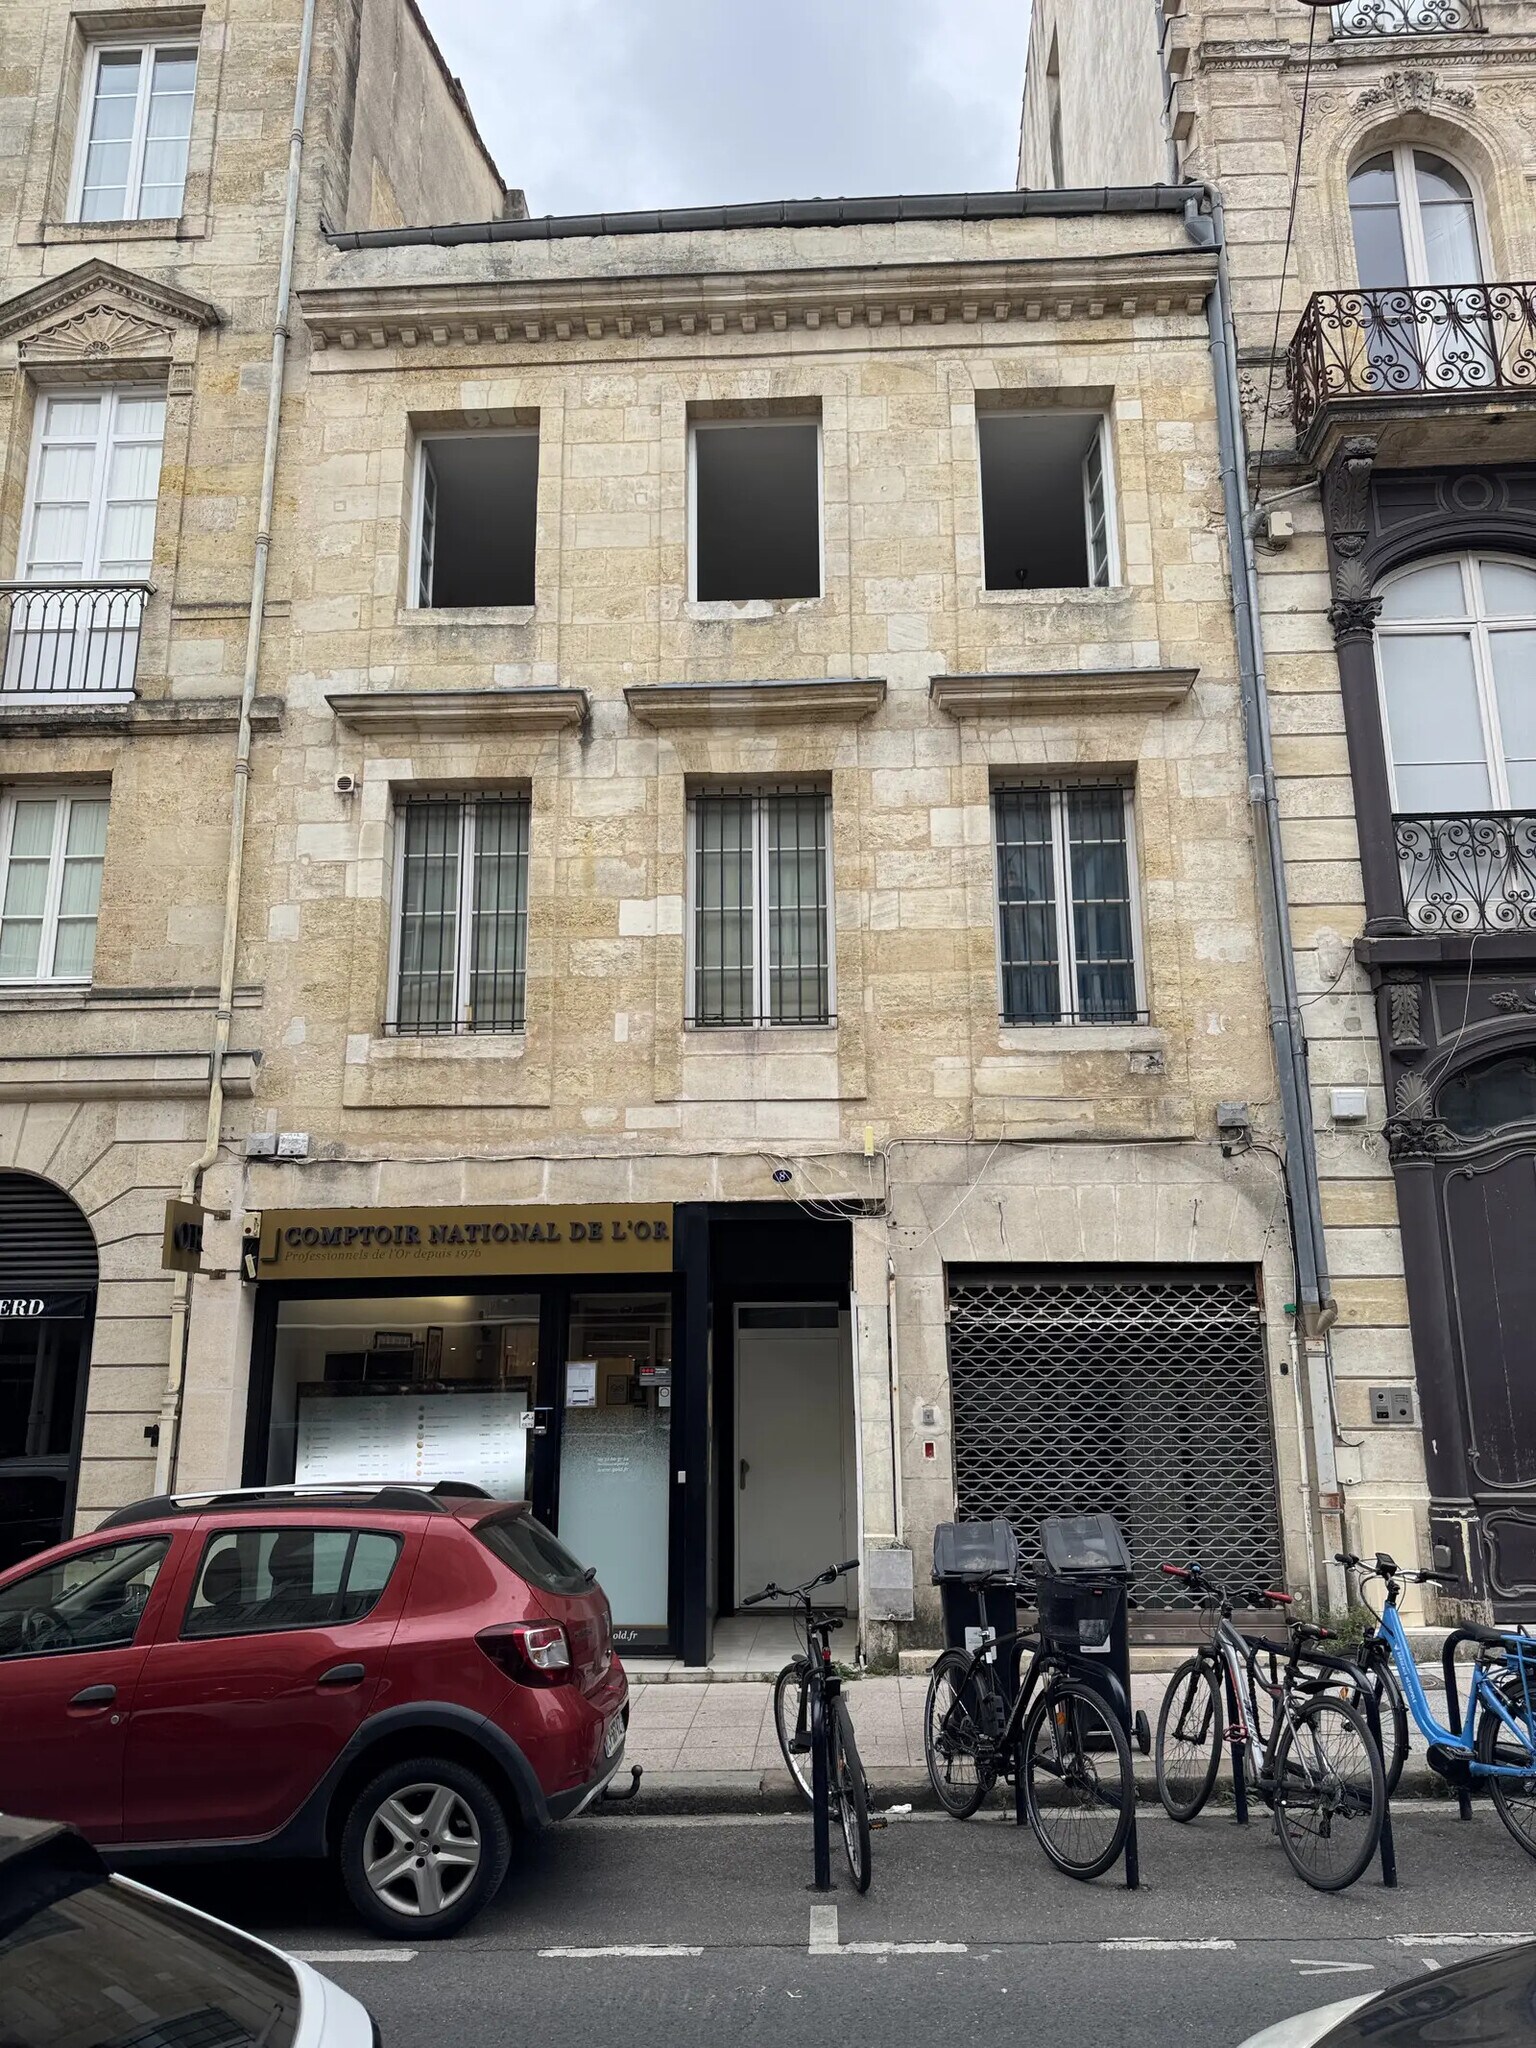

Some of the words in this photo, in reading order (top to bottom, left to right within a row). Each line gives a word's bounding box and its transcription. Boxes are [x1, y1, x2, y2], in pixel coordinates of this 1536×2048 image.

[284, 1224, 421, 1247] COMPTOIR
[428, 1222, 561, 1244] NATIONAL
[569, 1221, 603, 1242] DE
[611, 1220, 670, 1242] L'OR
[284, 1248, 369, 1263] Professionnels
[373, 1249, 385, 1260] de
[388, 1248, 411, 1260] l'Or
[413, 1248, 452, 1261] depuis
[456, 1248, 482, 1260] 1976
[0, 1299, 45, 1316] ERD
[612, 1630, 638, 1641] old.fr
